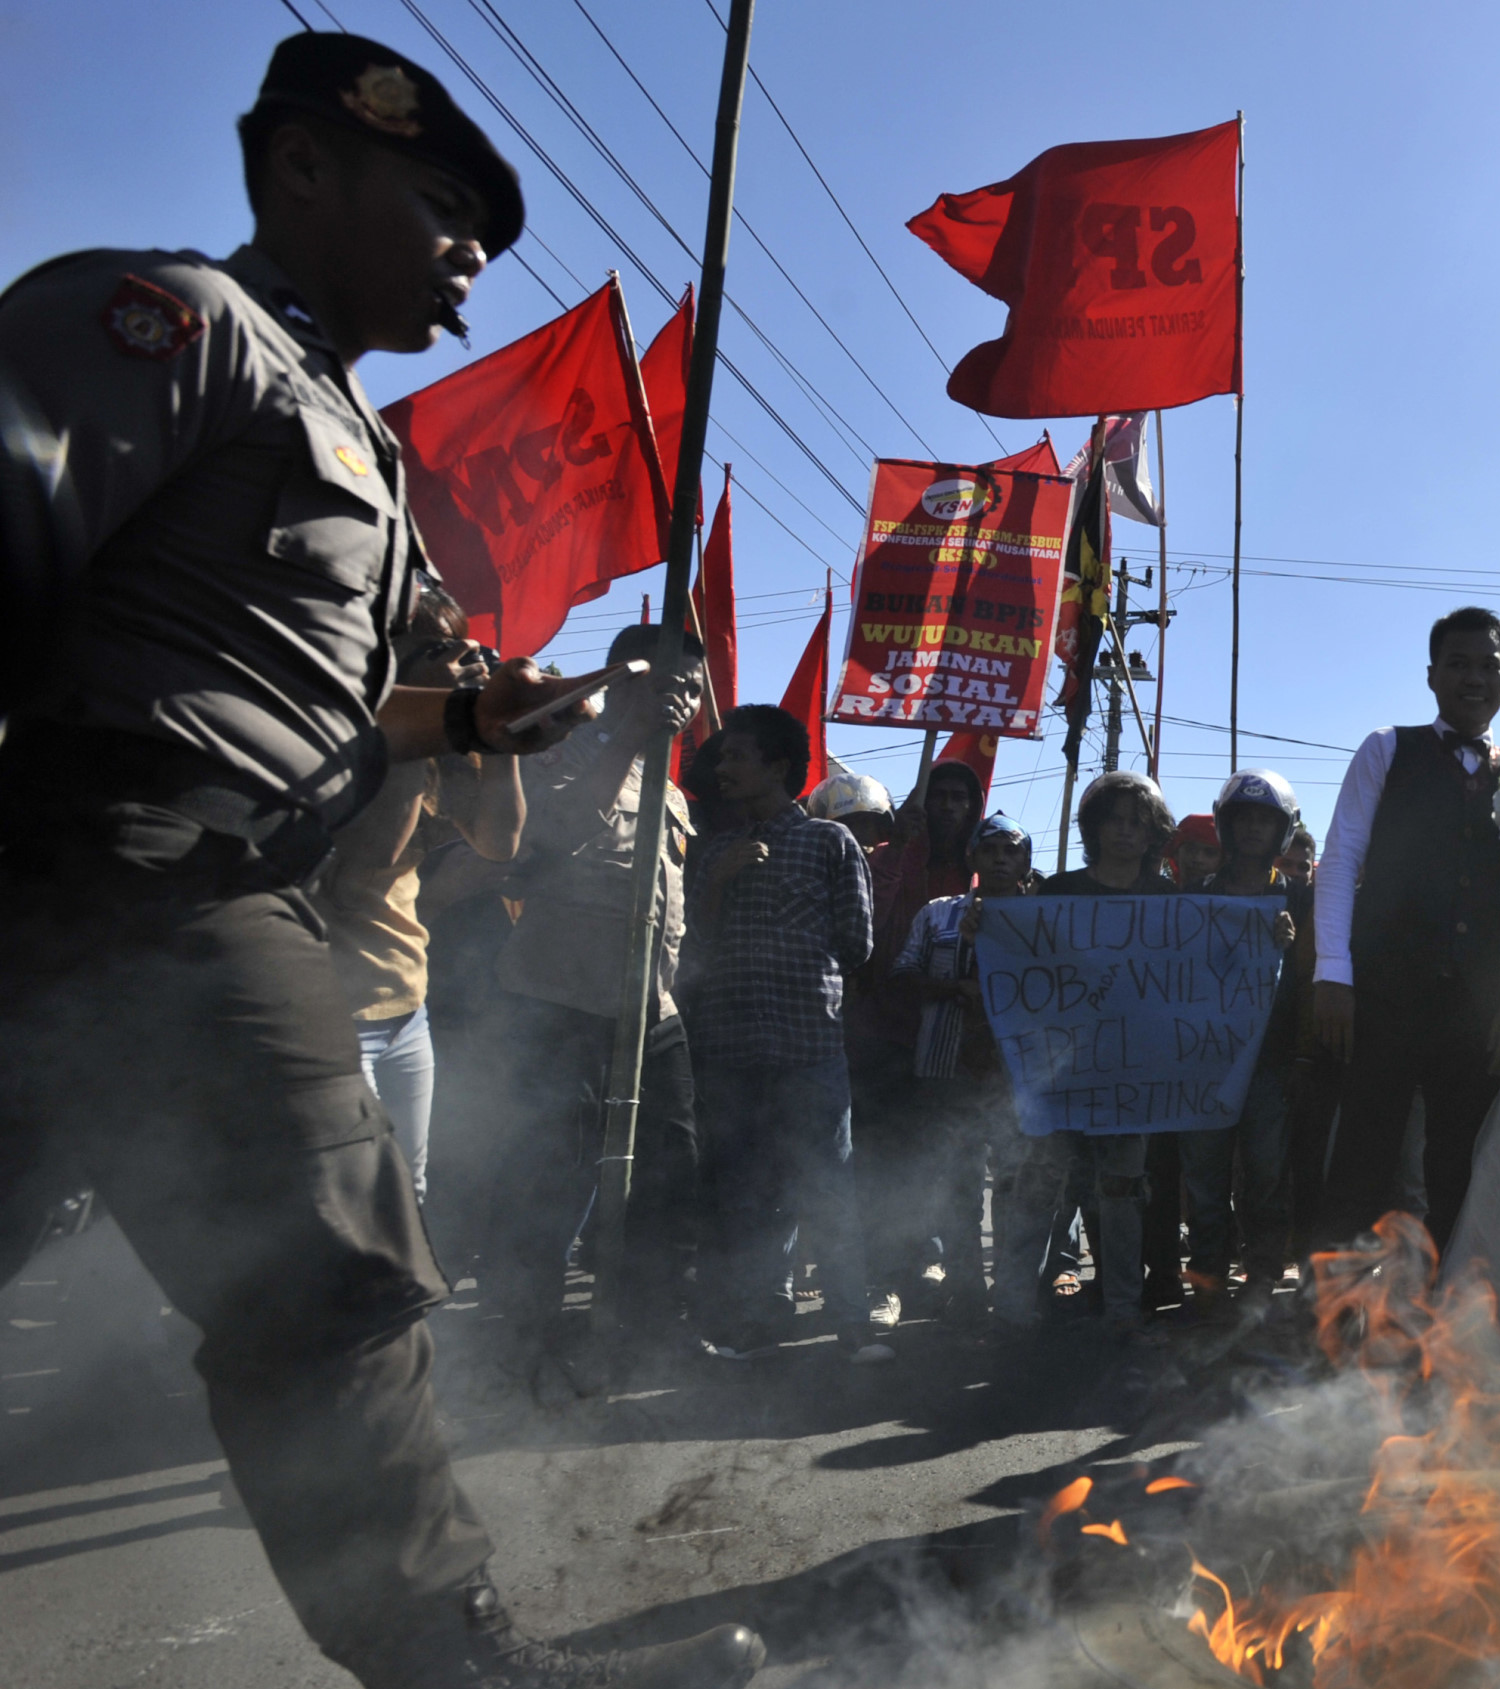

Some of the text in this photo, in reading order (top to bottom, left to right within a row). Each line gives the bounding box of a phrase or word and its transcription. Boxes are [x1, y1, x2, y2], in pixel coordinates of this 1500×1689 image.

[933, 499, 974, 515] KSN
[871, 532, 1061, 560] KONFEDERASI SERIKAT NUSANTARA
[929, 546, 998, 569] (KSN)
[864, 592, 1045, 630] BUKAN BPJS
[861, 623, 1042, 659] WUJUDKAN
[885, 650, 1012, 678] JAMINAN
[867, 672, 1018, 705] SOSIAL
[837, 695, 1038, 729] RAKYAT
[999, 897, 1278, 959] WUJUDKAN
[987, 964, 1089, 1017] DOB
[1087, 963, 1121, 1012] PADA
[1174, 1016, 1254, 1065] DAN
[1040, 1079, 1232, 1128] TERTING
